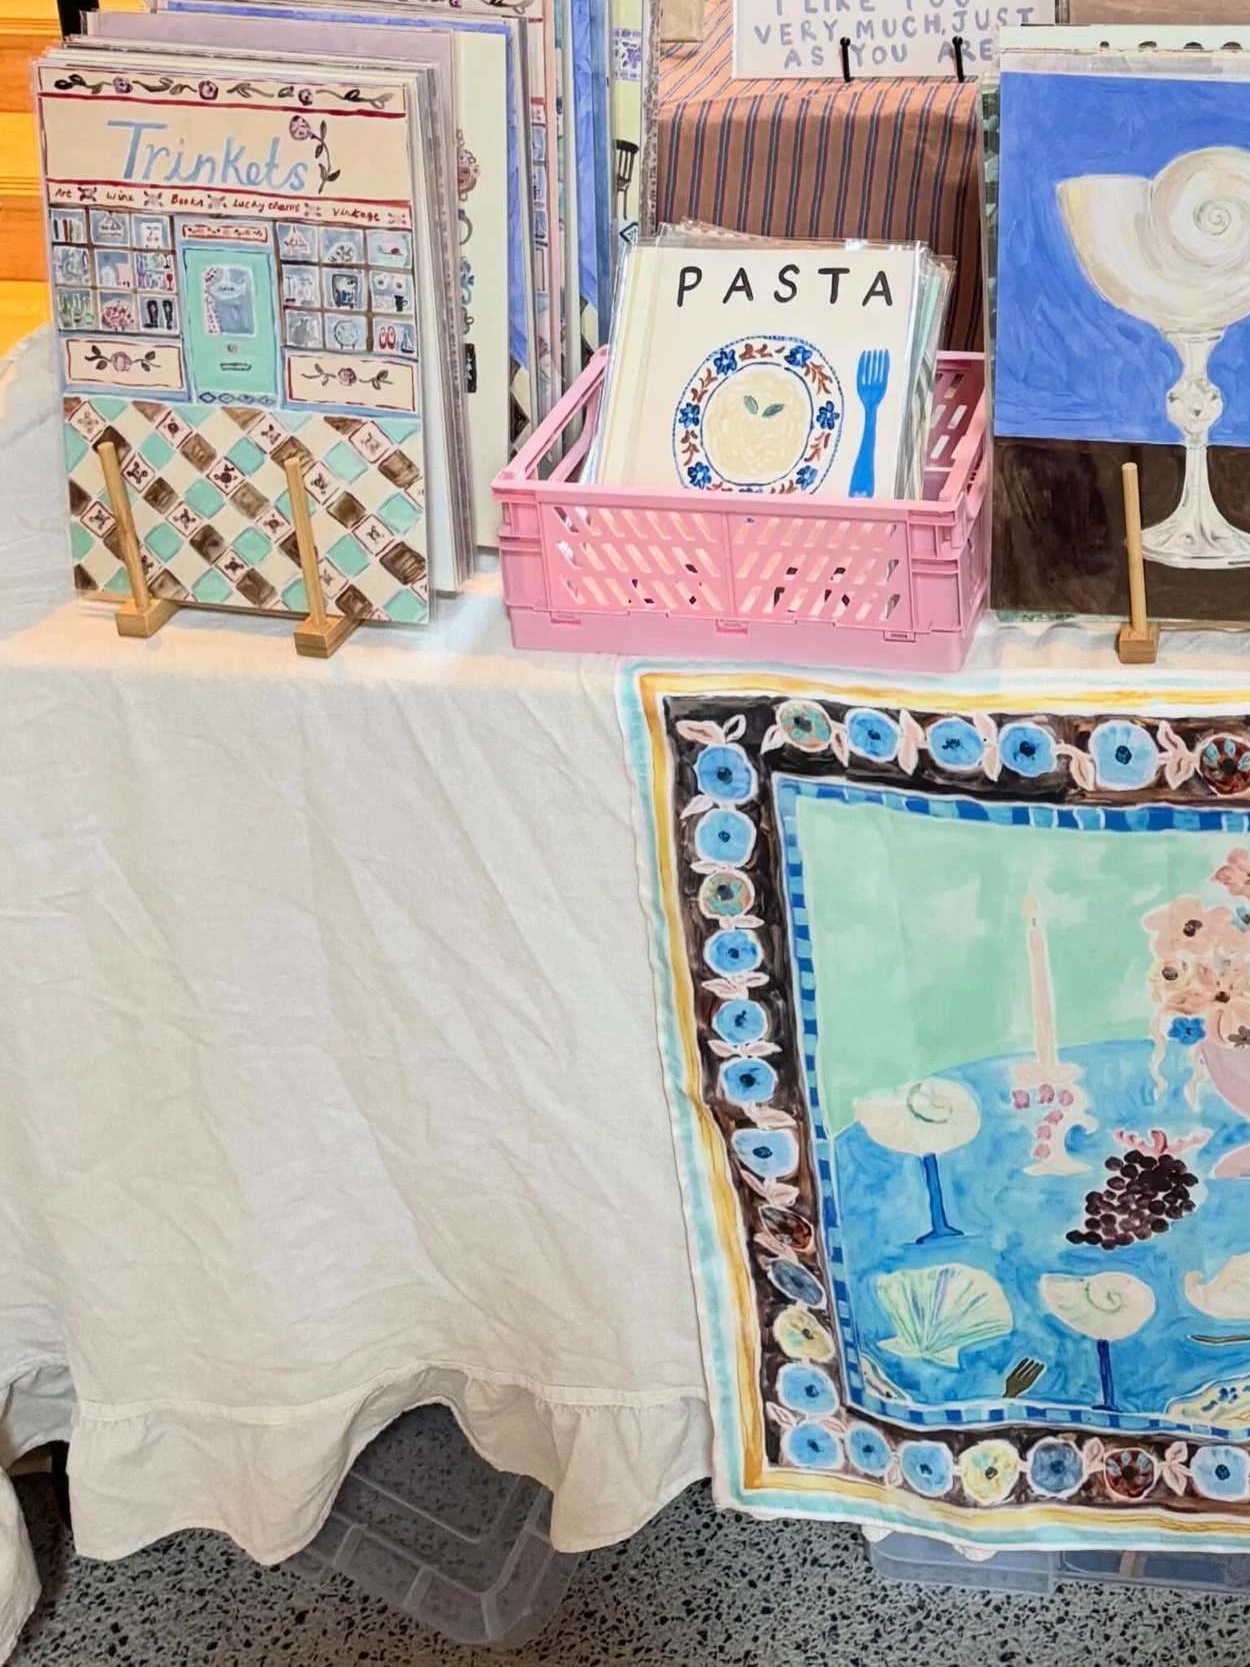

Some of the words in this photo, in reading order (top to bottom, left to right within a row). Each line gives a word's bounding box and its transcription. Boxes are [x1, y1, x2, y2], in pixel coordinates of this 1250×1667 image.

[753, 19, 838, 46] VERY
[952, 7, 1035, 32] JUST
[784, 46, 825, 69] AS
[851, 43, 908, 67] YOU
[938, 38, 995, 64] ARE
[106, 119, 309, 192] Trinkets
[676, 263, 894, 308] PASTA
